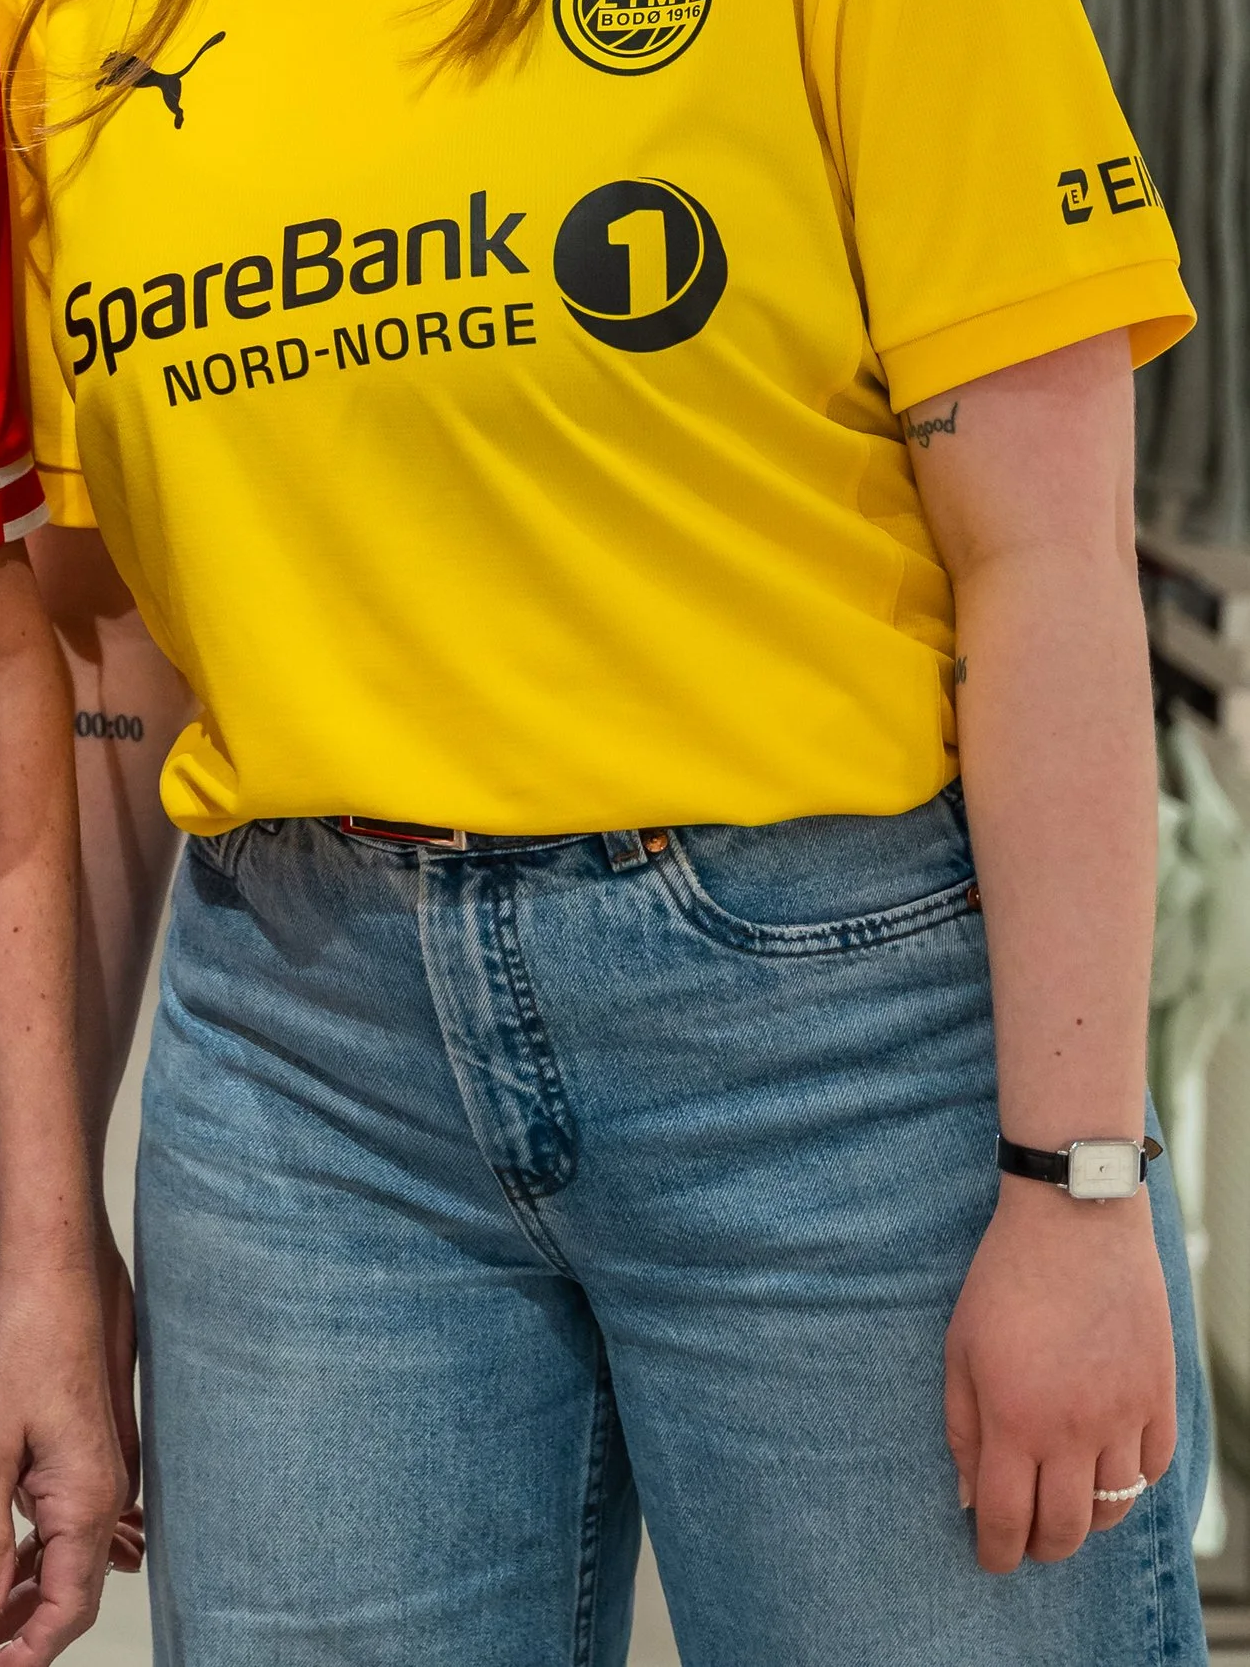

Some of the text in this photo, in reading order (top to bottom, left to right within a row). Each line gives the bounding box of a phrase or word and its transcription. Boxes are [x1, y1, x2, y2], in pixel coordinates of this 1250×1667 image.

[601, 4, 701, 27] BODØ 1916
[65, 190, 531, 377] SpareBank
[162, 302, 538, 408] NORD-NORGE
[76, 711, 144, 742] 00:00
